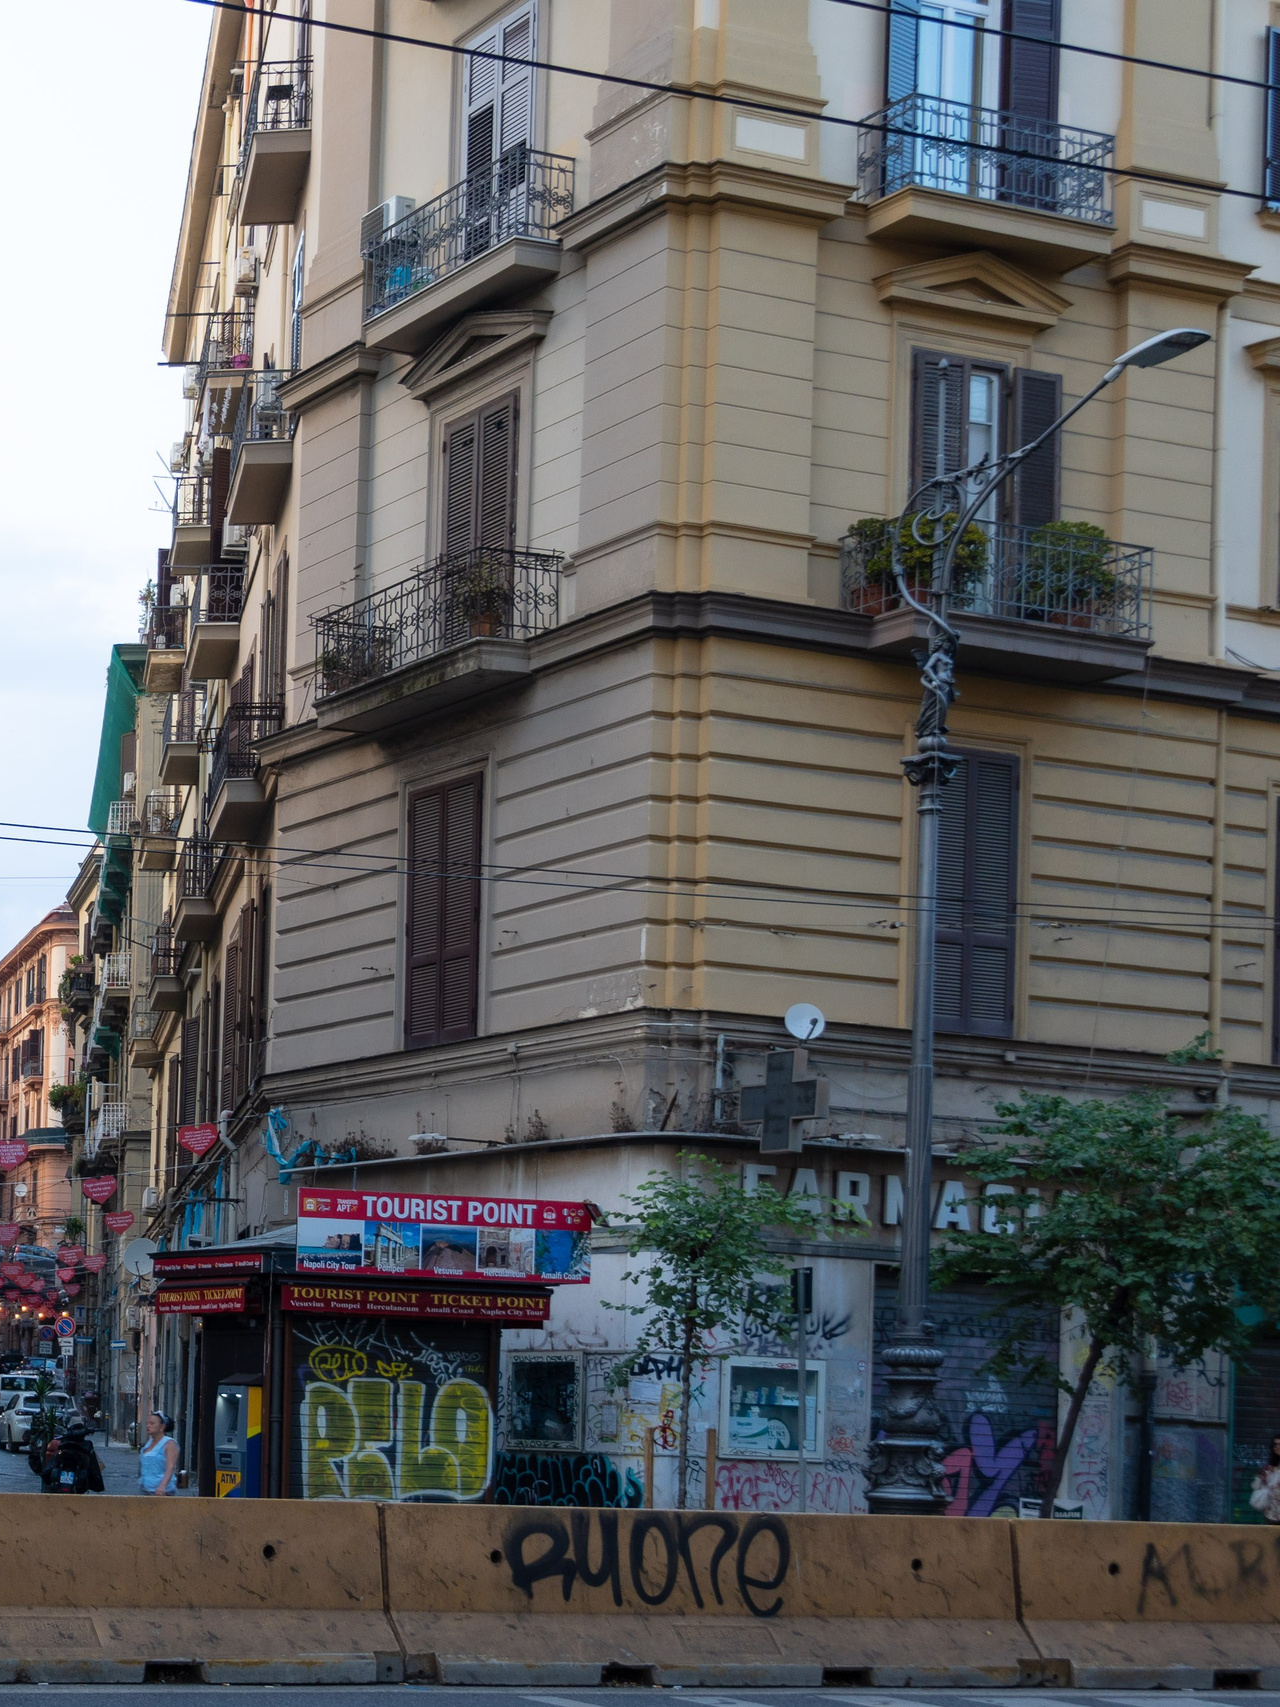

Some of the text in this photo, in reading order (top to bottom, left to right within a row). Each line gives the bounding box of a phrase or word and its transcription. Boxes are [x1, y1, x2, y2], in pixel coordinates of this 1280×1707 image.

[337, 1204, 350, 1212] APT
[363, 1196, 538, 1225] TOURIST POINT
[304, 1260, 356, 1271] Napoli City Tour
[434, 1266, 463, 1276] Vesuvius
[483, 1269, 526, 1278] Herculaneum
[541, 1272, 582, 1280] Amalfi Coast
[159, 1288, 243, 1303] TOURIST POINT TICKET POINT
[290, 1287, 546, 1309] TOURIST POINT TICKET POINT
[290, 1300, 324, 1308] Vesuvius
[330, 1302, 360, 1310] Pompei
[367, 1303, 419, 1312] Herculaneum
[480, 1308, 506, 1316] Naples
[221, 1474, 236, 1484] ATM
